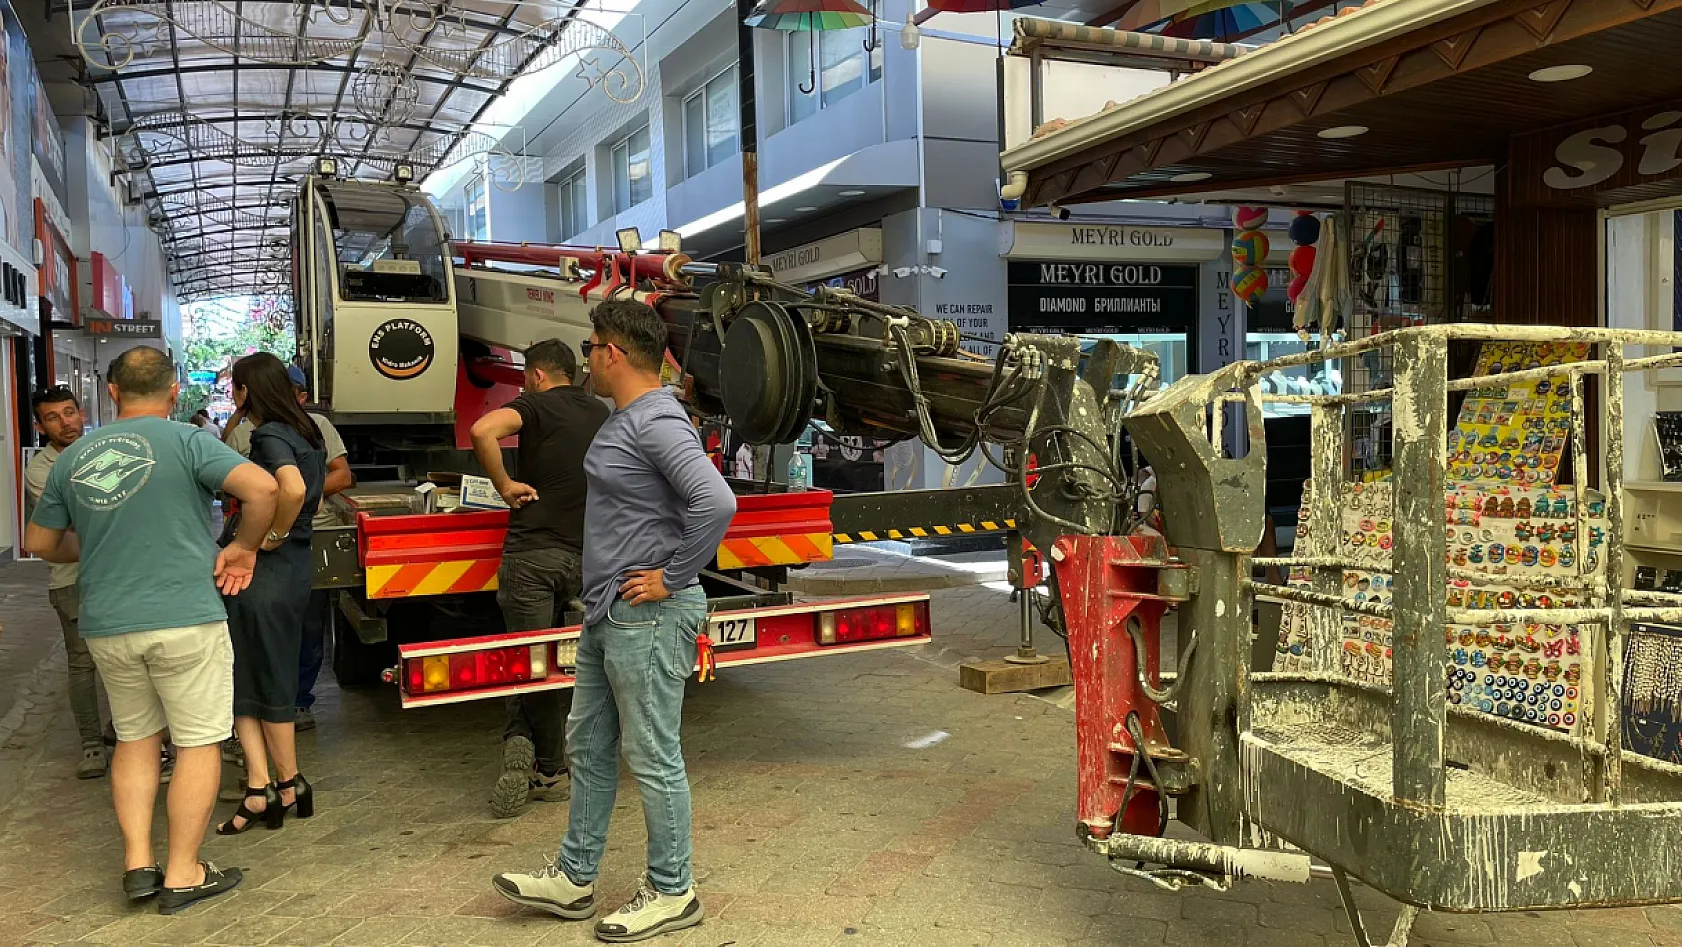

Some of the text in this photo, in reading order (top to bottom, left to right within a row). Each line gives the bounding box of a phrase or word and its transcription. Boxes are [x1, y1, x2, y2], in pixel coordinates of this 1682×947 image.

[1130, 230, 1173, 247] GOLD
[799, 246, 820, 265] GOLD
[1110, 265, 1162, 284] GOLD
[935, 304, 993, 314] WE CAN REPAIR
[1039, 297, 1087, 313] DIAMOND
[1094, 297, 1161, 313] БРИЛЛИАНТЫ
[89, 321, 156, 334] IN STREET
[956, 318, 967, 328] OF
[968, 318, 989, 328] YOUR
[384, 321, 432, 346] PLATFORM
[717, 618, 749, 643] 127
